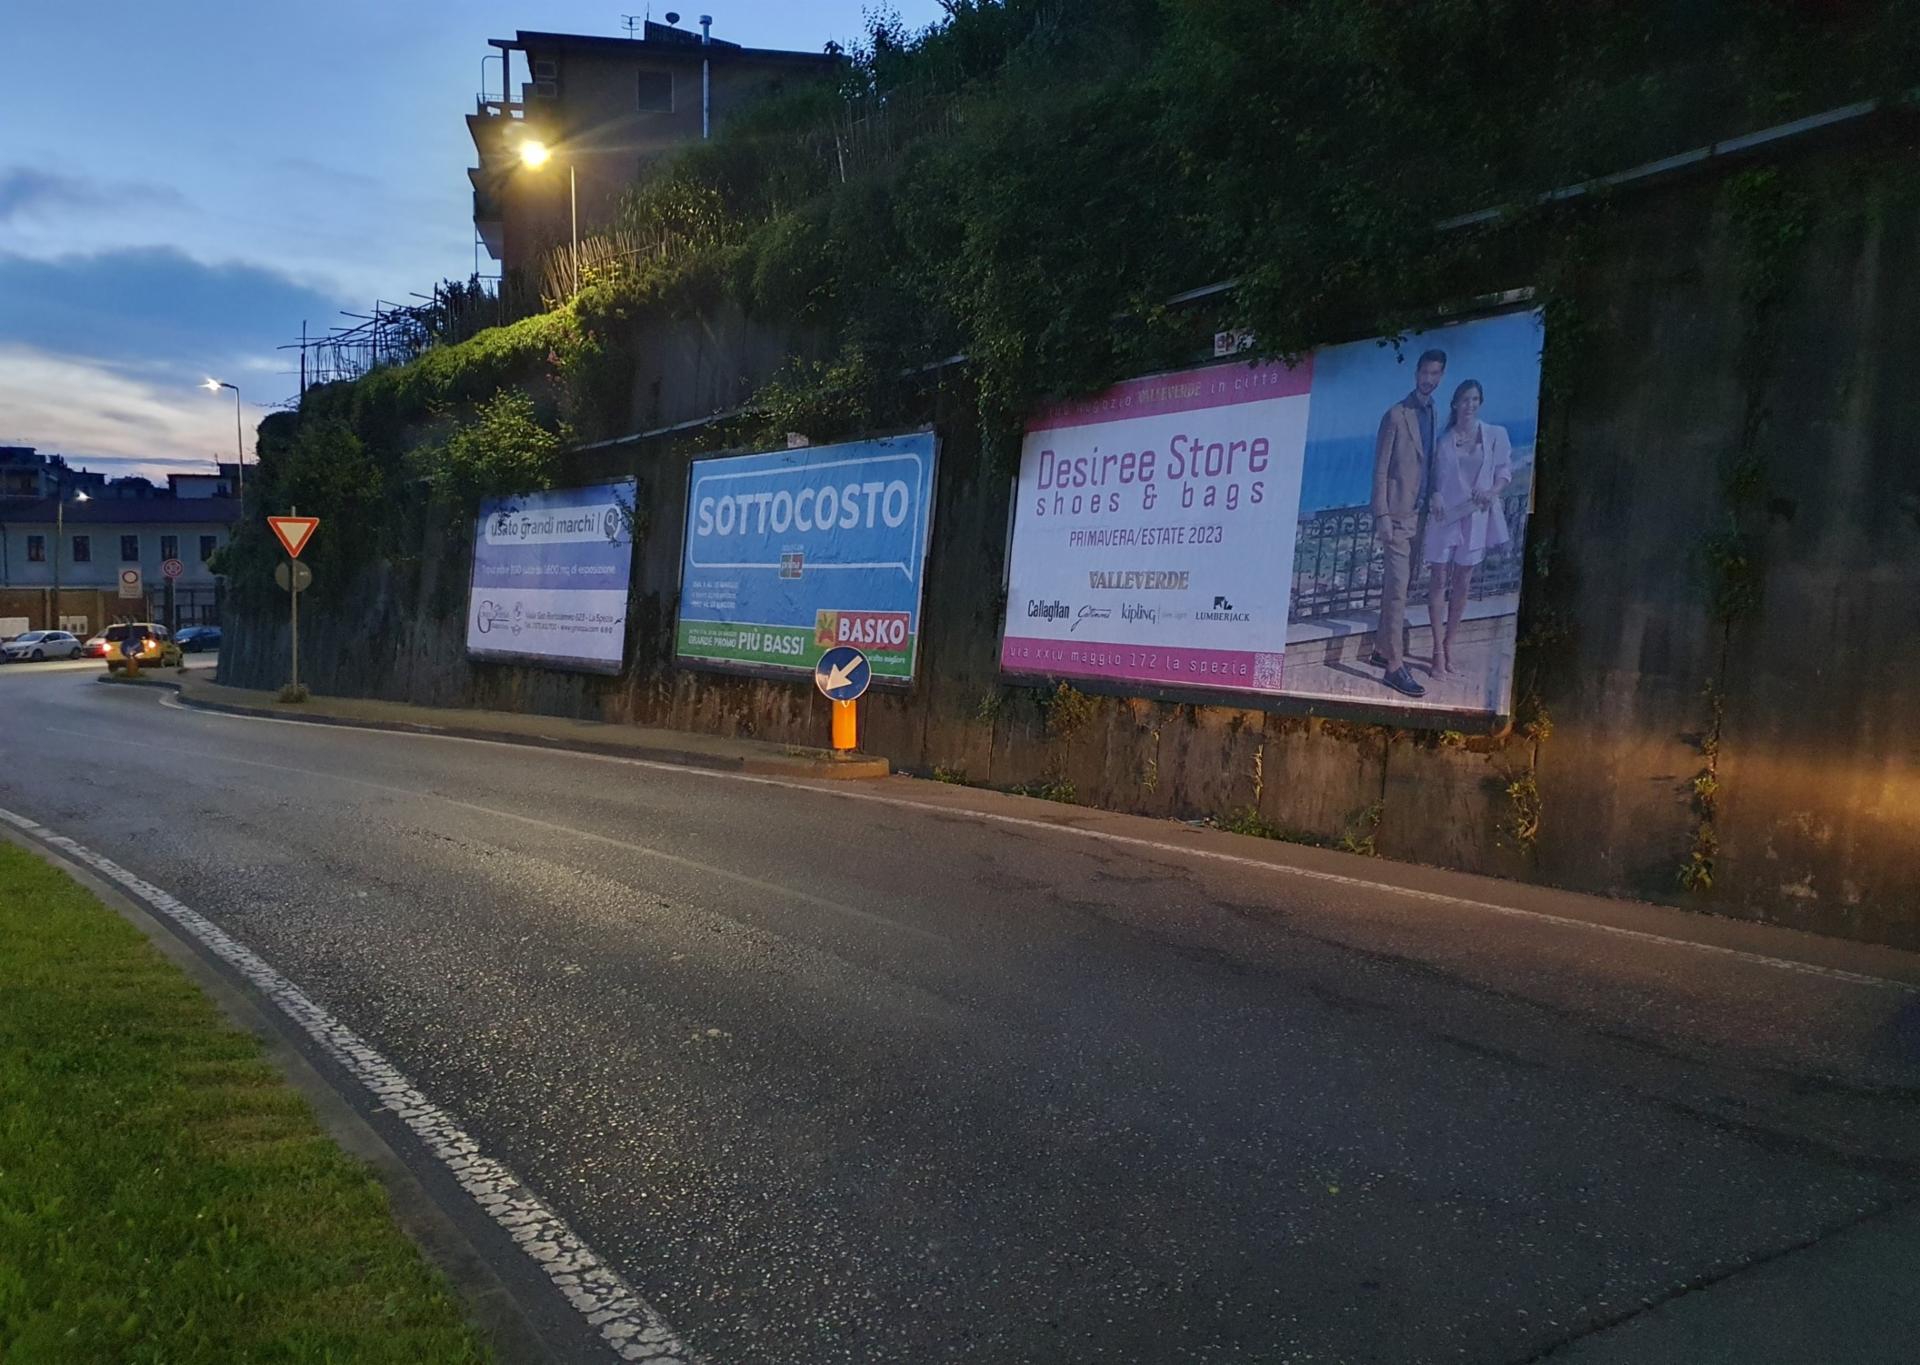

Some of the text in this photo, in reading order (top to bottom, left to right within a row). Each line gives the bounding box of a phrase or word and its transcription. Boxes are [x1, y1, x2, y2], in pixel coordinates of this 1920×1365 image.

[1210, 382, 1226, 394] in
[1037, 434, 1269, 490] Desiree Store
[697, 480, 909, 536] SOTTOCOSTO
[1036, 480, 1265, 517] shoes & bags
[491, 512, 594, 539] usato grandi marchi
[1069, 525, 1223, 547] PRIMAVERA/ESTATE 2023
[1089, 570, 1189, 590] VALLEVERDE
[1195, 610, 1251, 623] LUMBERJACK
[713, 637, 737, 648] PROMO
[738, 628, 805, 656] PIÙ BASSI
[838, 617, 905, 645] BASKO
[1009, 647, 1029, 658] via
[1070, 651, 1122, 667] maggio
[1129, 652, 1157, 668] 172
[1166, 655, 1180, 671] la
[1189, 660, 1248, 676] spezia
